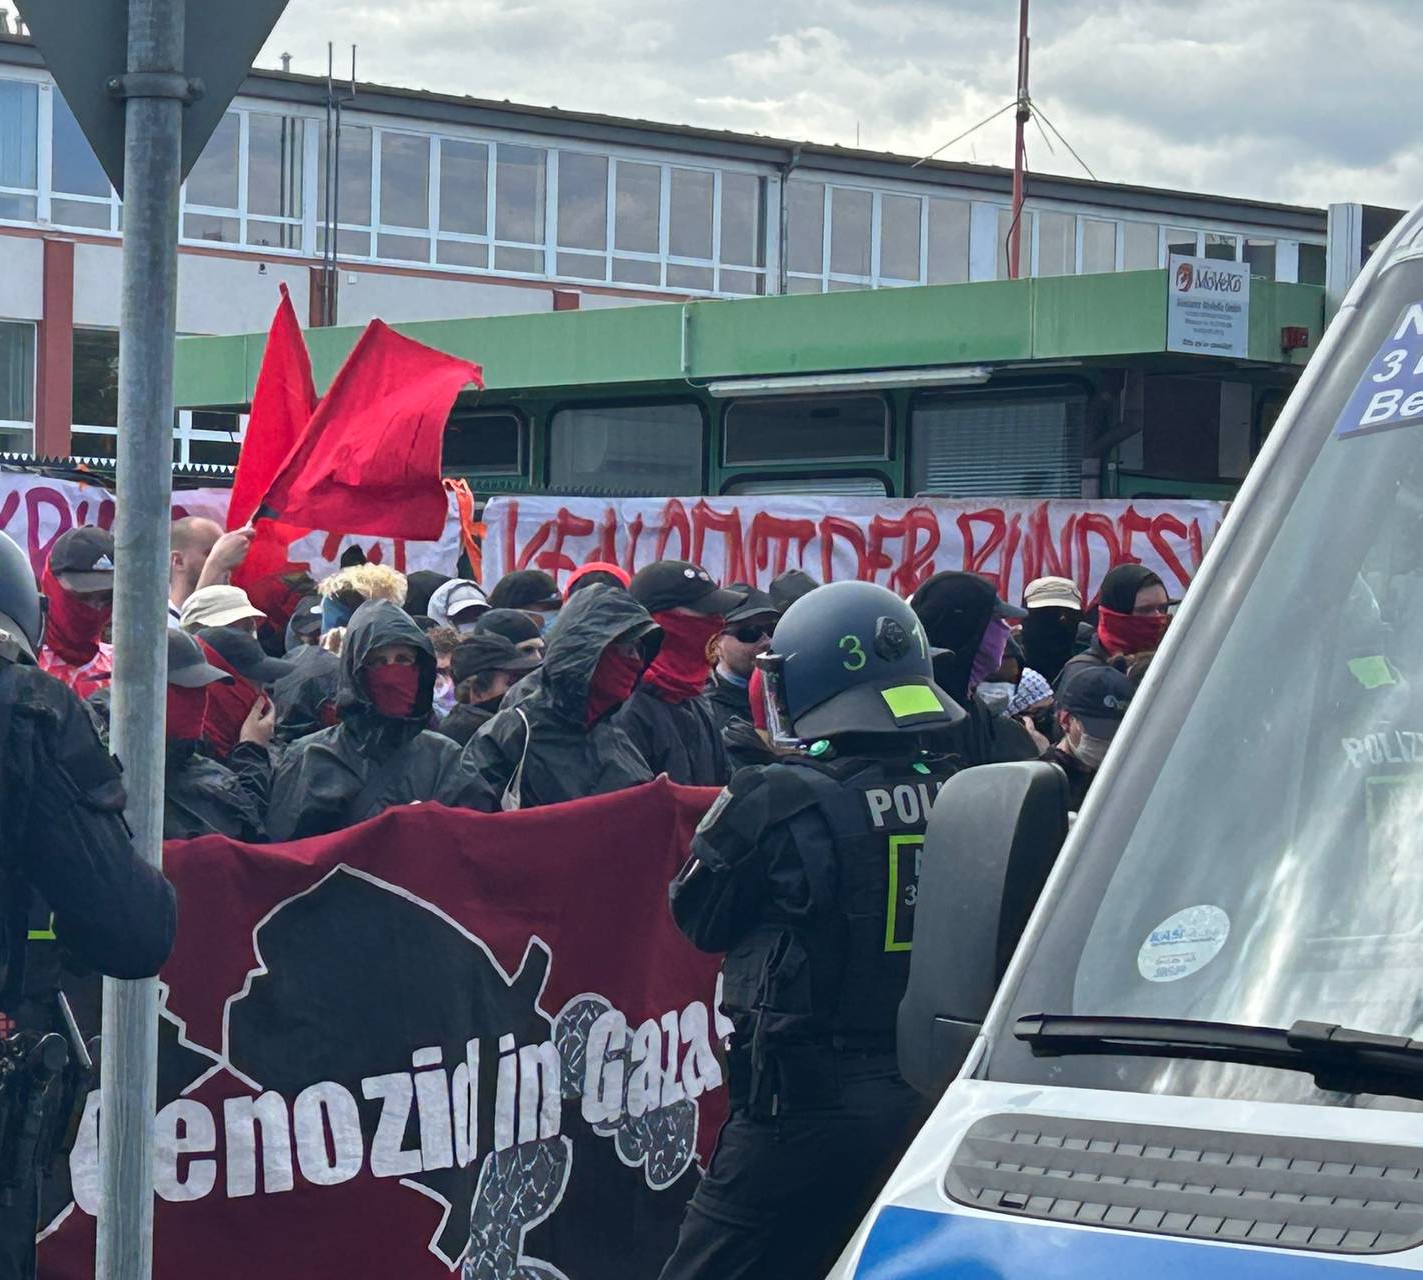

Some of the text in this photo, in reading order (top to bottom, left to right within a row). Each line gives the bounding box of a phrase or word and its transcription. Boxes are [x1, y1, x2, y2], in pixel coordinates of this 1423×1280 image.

[1372, 348, 1408, 383] 3
[956, 500, 1205, 614] BUNDES
[838, 634, 868, 672] 3
[494, 1032, 562, 1153] in
